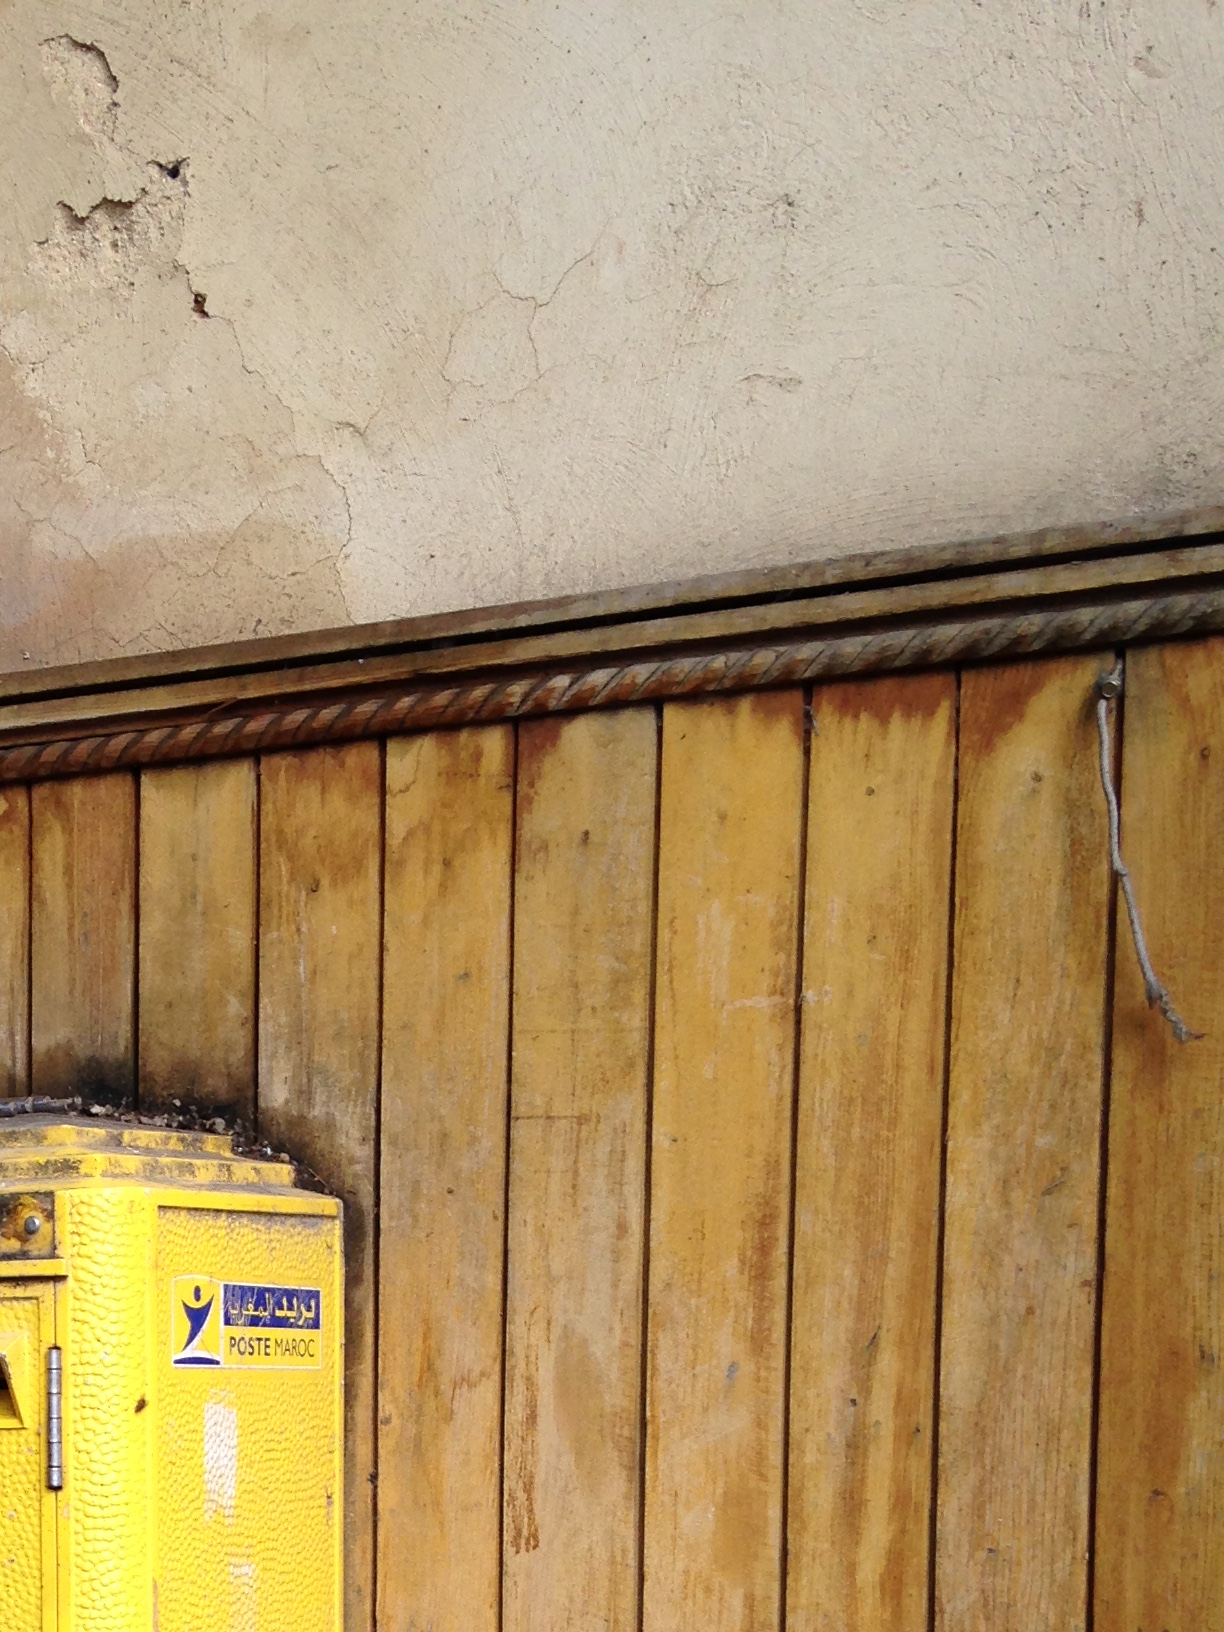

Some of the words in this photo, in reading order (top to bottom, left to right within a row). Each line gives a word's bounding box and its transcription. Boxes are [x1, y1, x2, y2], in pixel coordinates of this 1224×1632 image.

[275, 1295, 316, 1326] بريد
[229, 1335, 271, 1357] POSTE
[274, 1337, 315, 1358] MAROC
